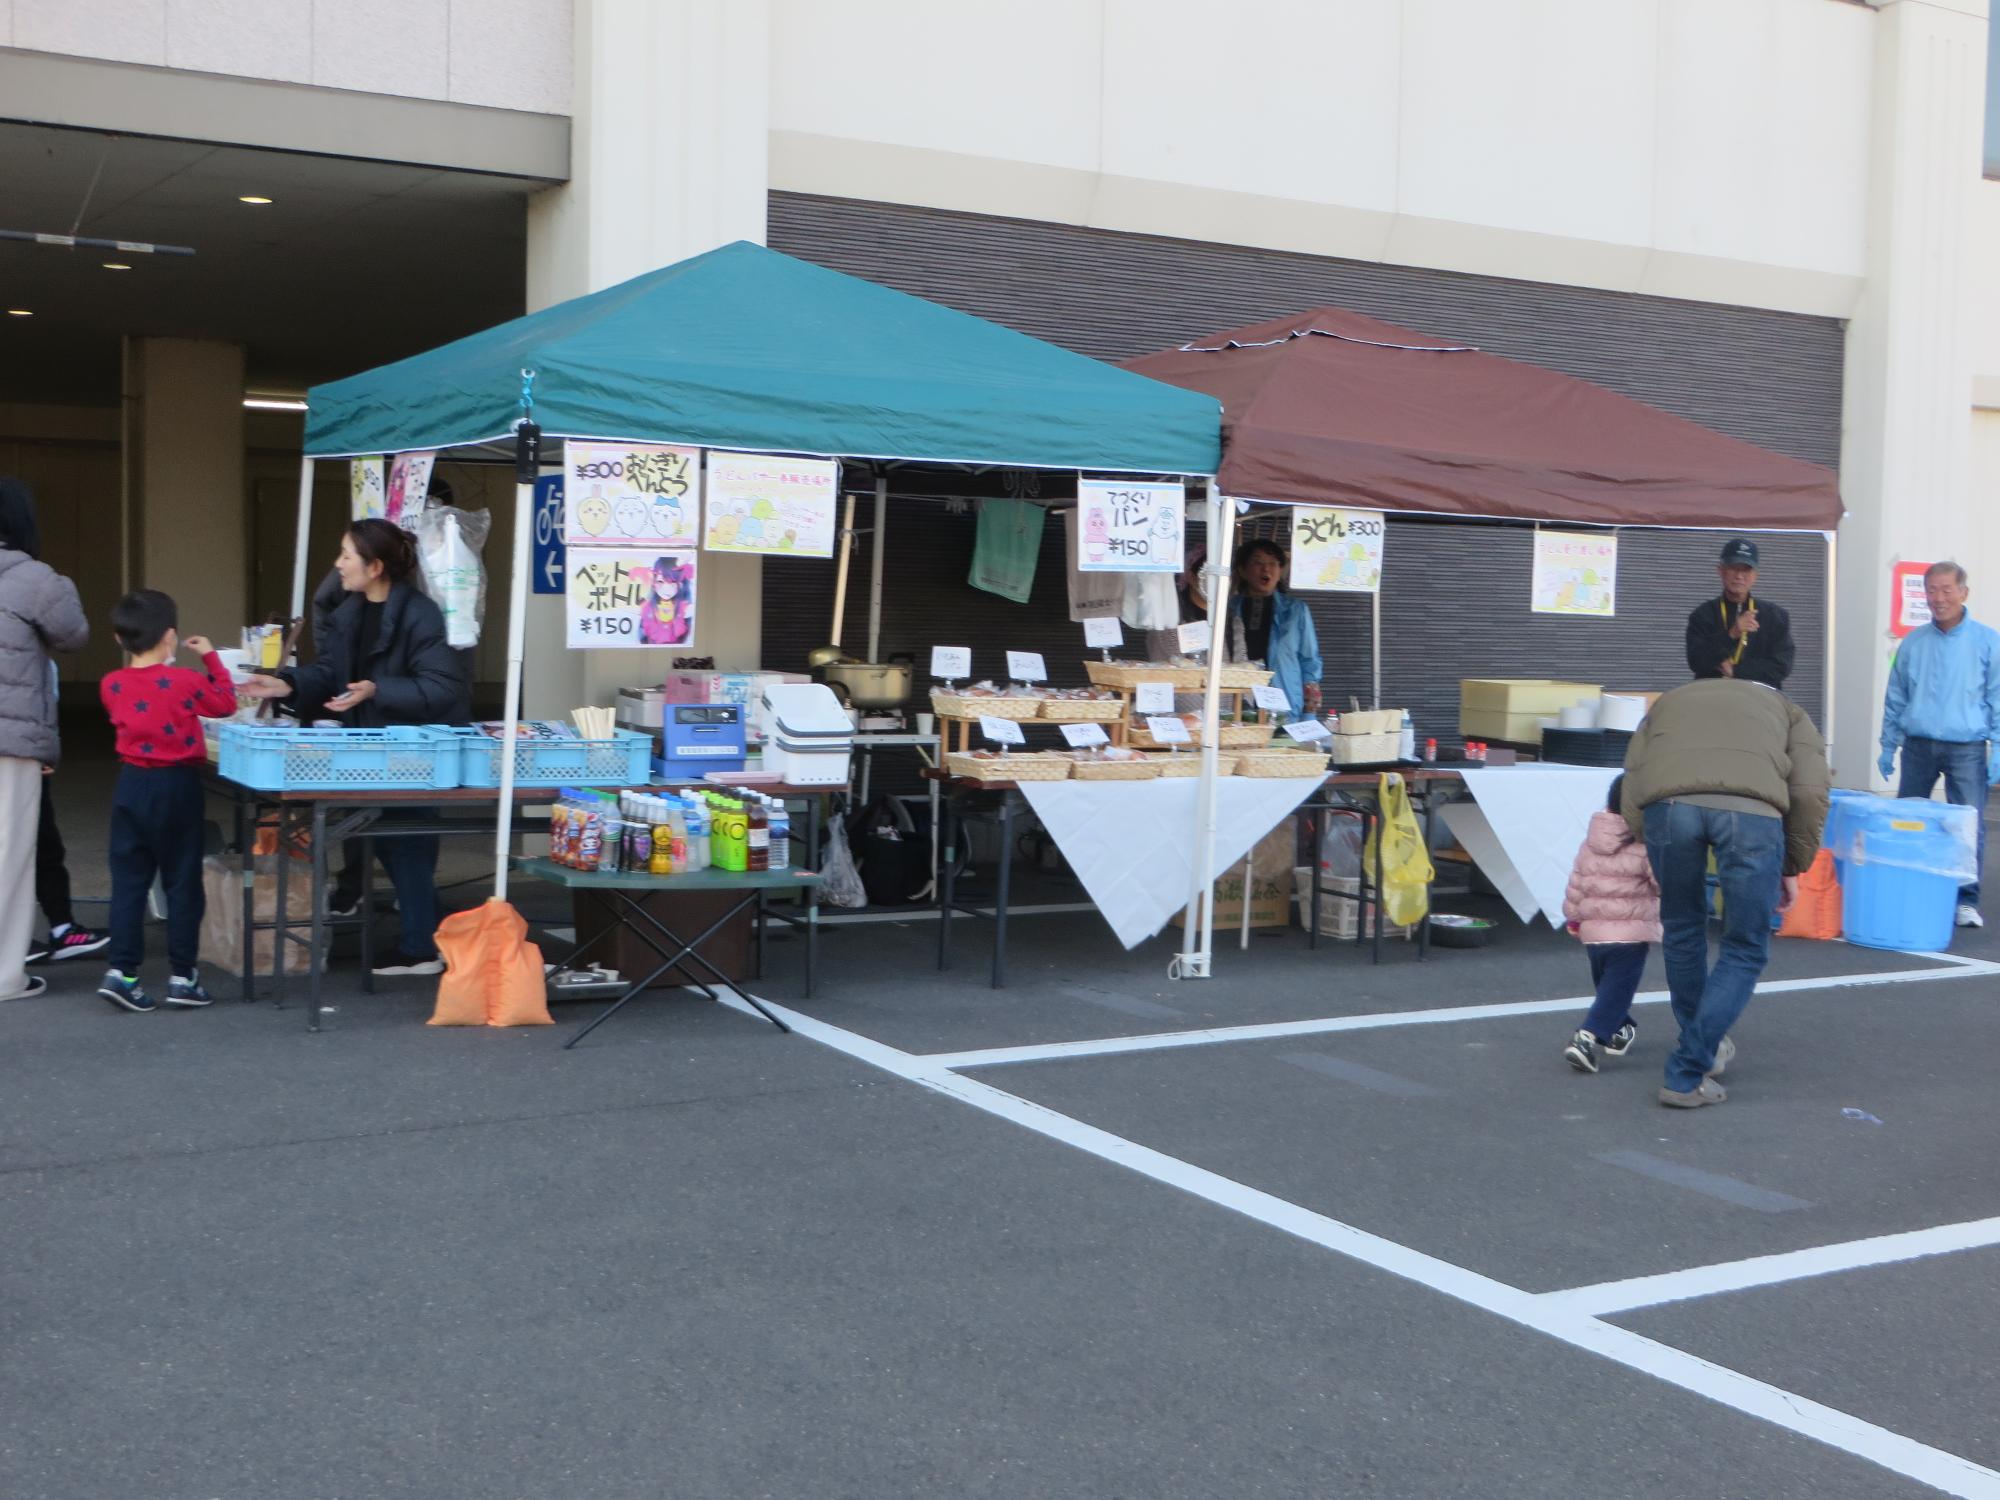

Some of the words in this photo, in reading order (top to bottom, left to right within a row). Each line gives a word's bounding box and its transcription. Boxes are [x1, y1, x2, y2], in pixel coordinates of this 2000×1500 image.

[577, 461, 624, 480] ¥300
[1108, 538, 1149, 556] ¥150
[576, 561, 630, 586] ペット
[587, 583, 647, 611] ボトル
[580, 617, 633, 635] ¥150
